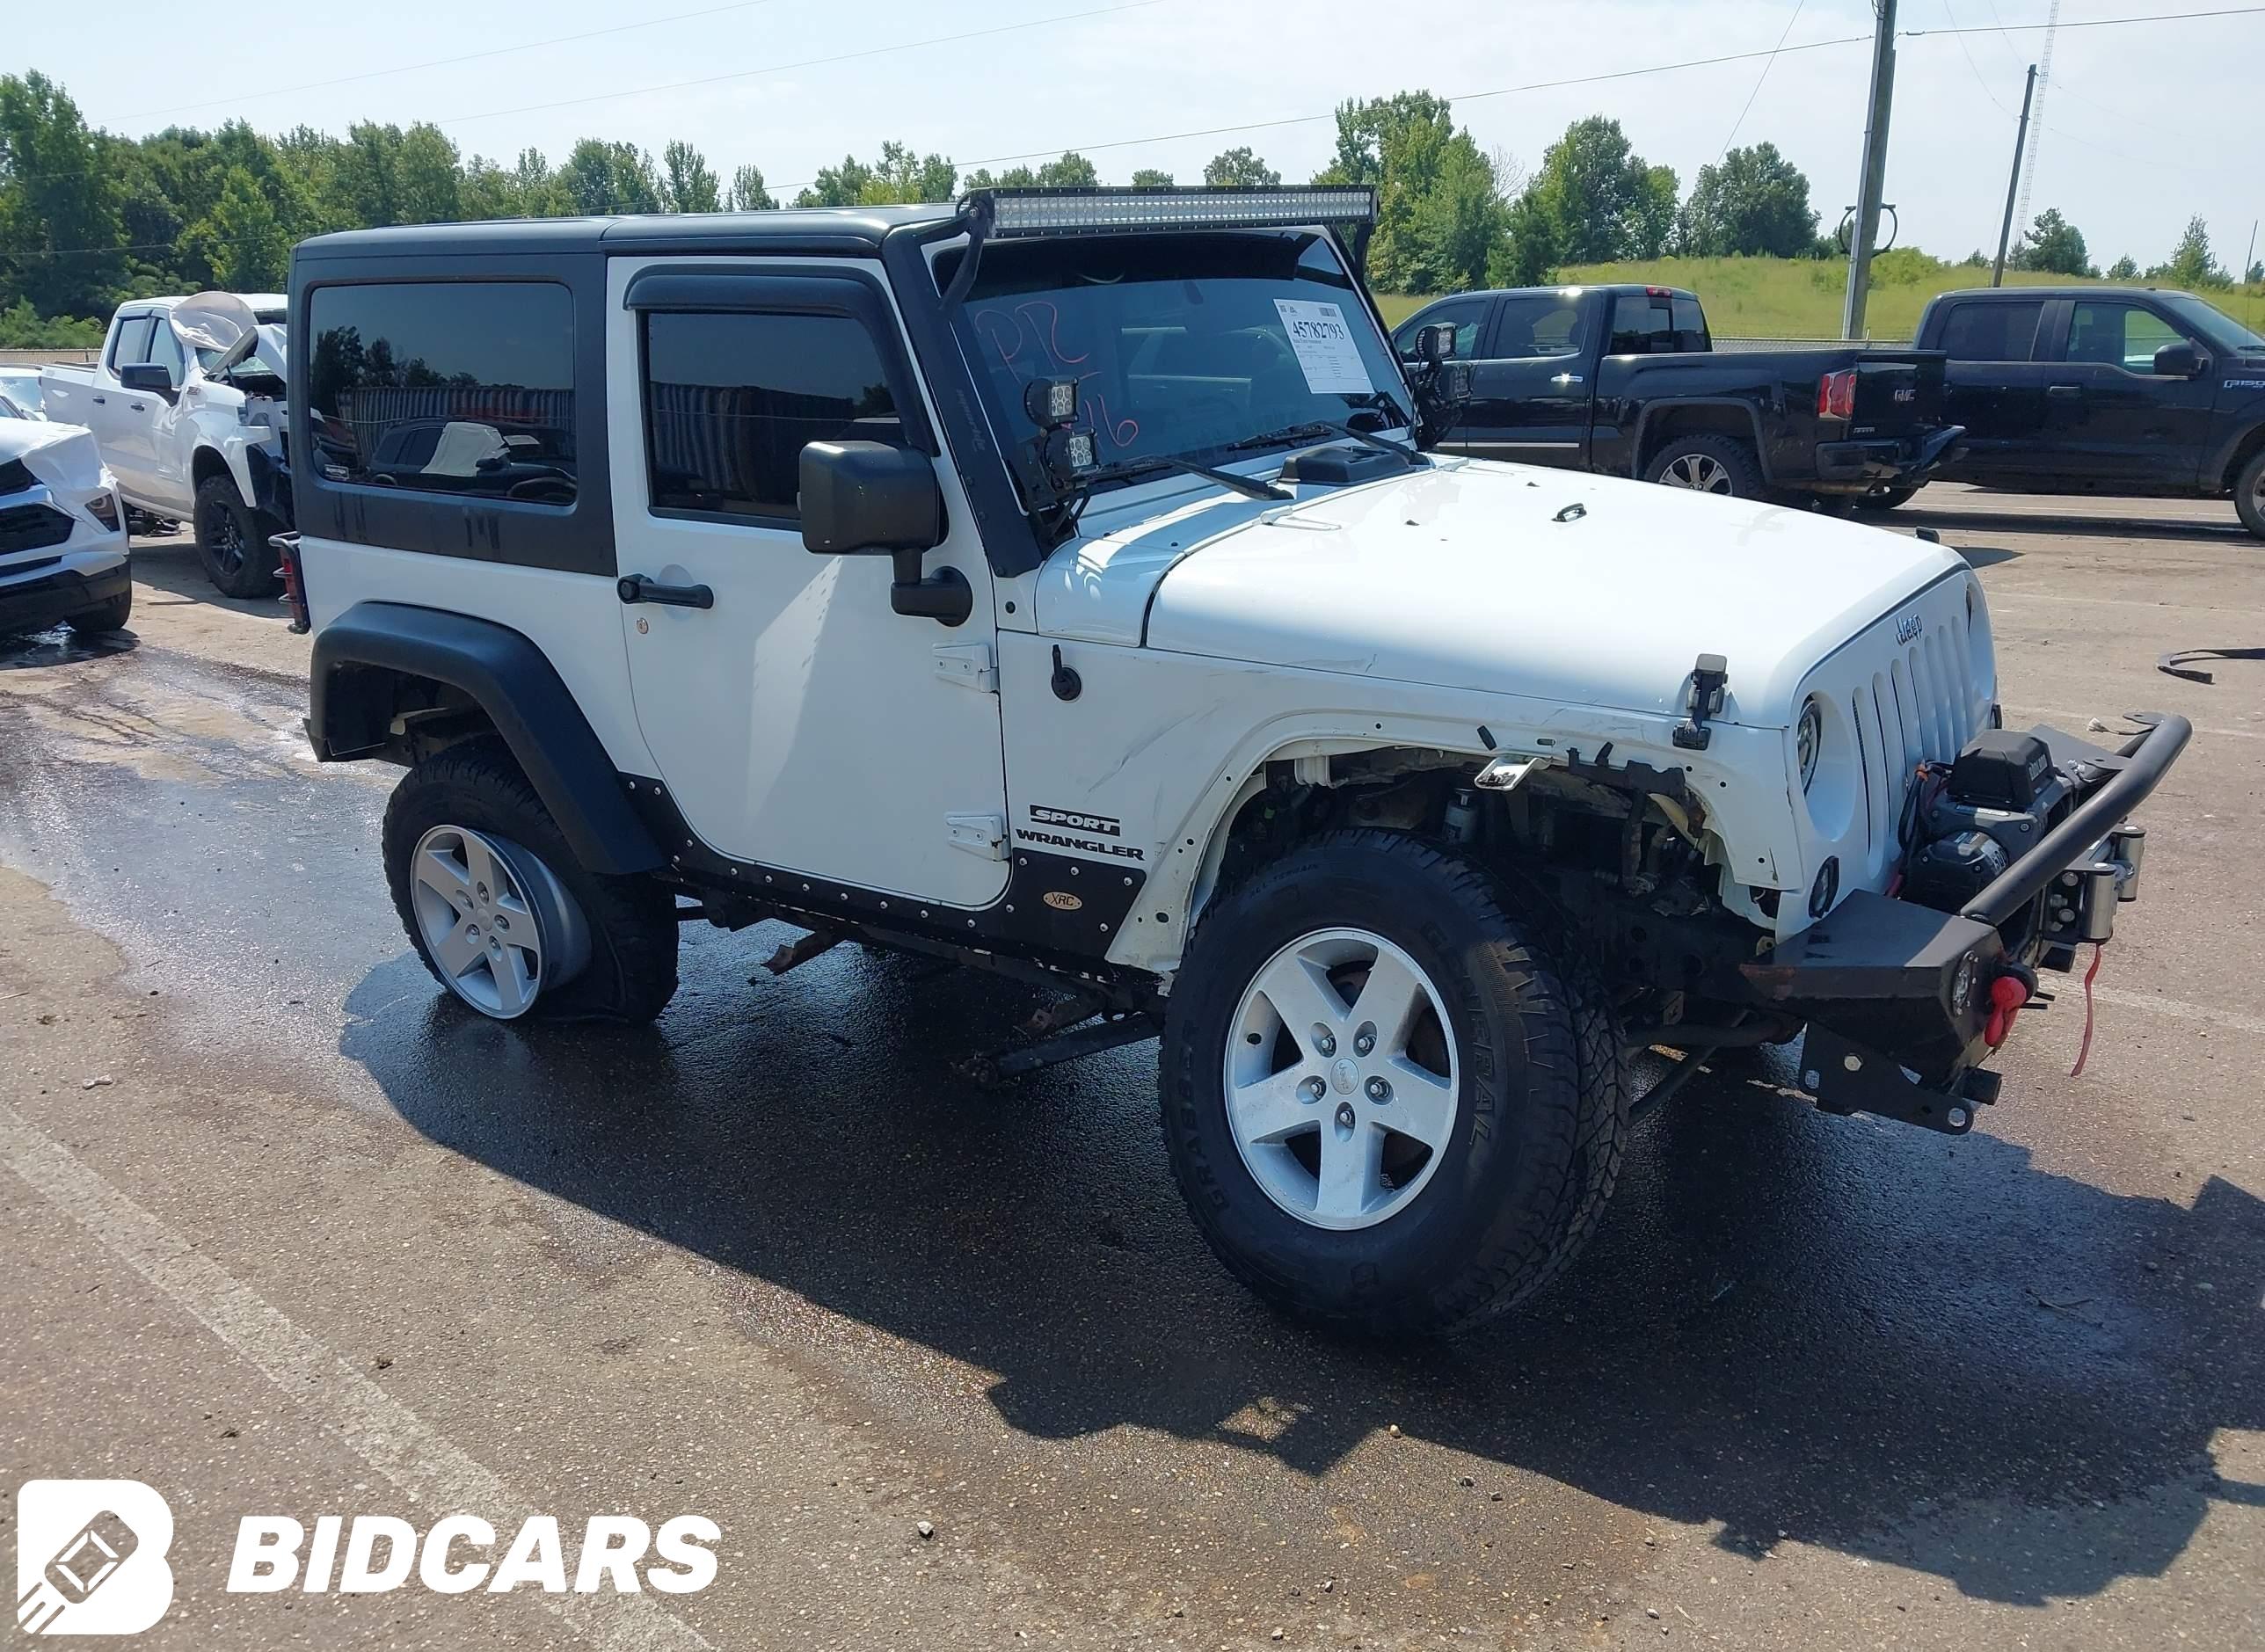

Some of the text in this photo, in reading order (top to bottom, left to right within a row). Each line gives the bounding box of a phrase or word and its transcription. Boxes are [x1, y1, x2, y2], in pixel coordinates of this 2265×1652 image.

[1292, 321, 1344, 340] 45782793
[1894, 389, 1917, 401] GMC
[1896, 614, 1922, 647] Jeep
[1034, 809, 1120, 832] SPORT
[1016, 829, 1146, 861] WRANGLER
[1051, 892, 1074, 906] XRC
